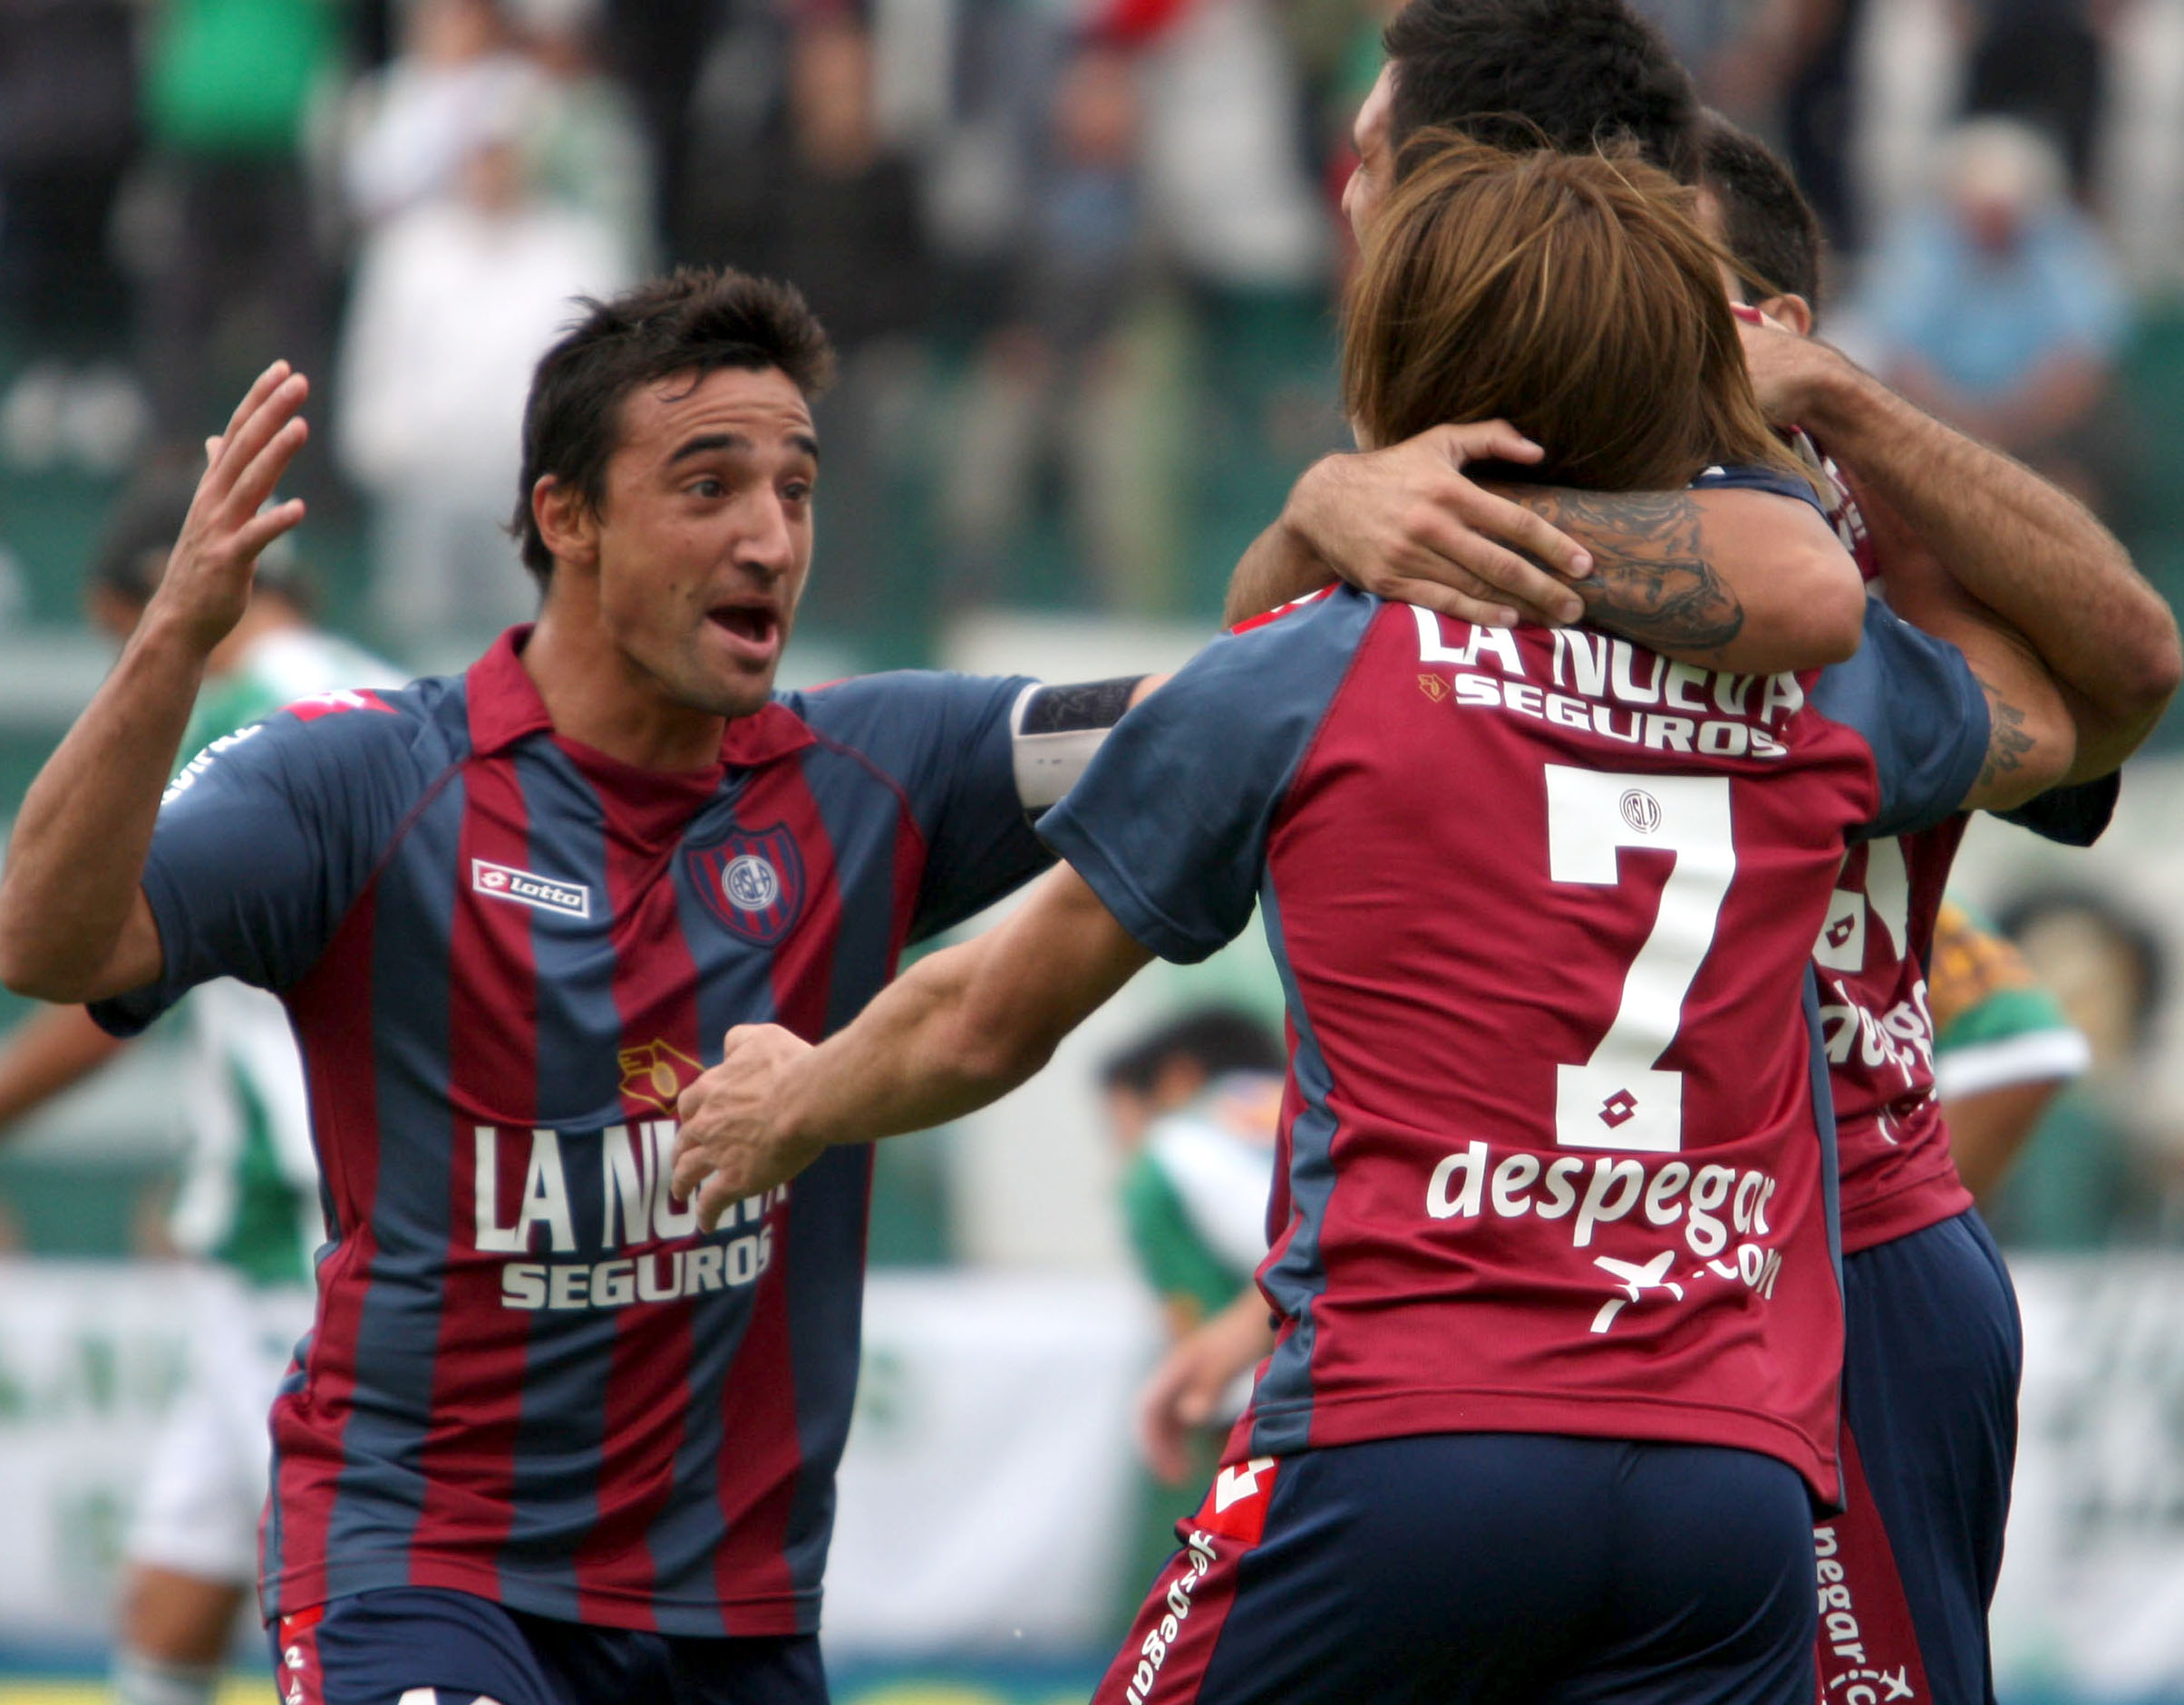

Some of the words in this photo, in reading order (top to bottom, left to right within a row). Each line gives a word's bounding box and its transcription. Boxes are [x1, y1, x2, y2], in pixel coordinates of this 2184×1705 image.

[1408, 605, 1526, 676] LA
[1550, 628, 1804, 724] NUEVA
[1455, 673, 1789, 758] SEGUROS
[1544, 763, 1736, 1152] 7
[474, 1126, 577, 1253] LA
[1426, 1140, 1775, 1257] despegar
[501, 1227, 773, 1311] SEGUROS
